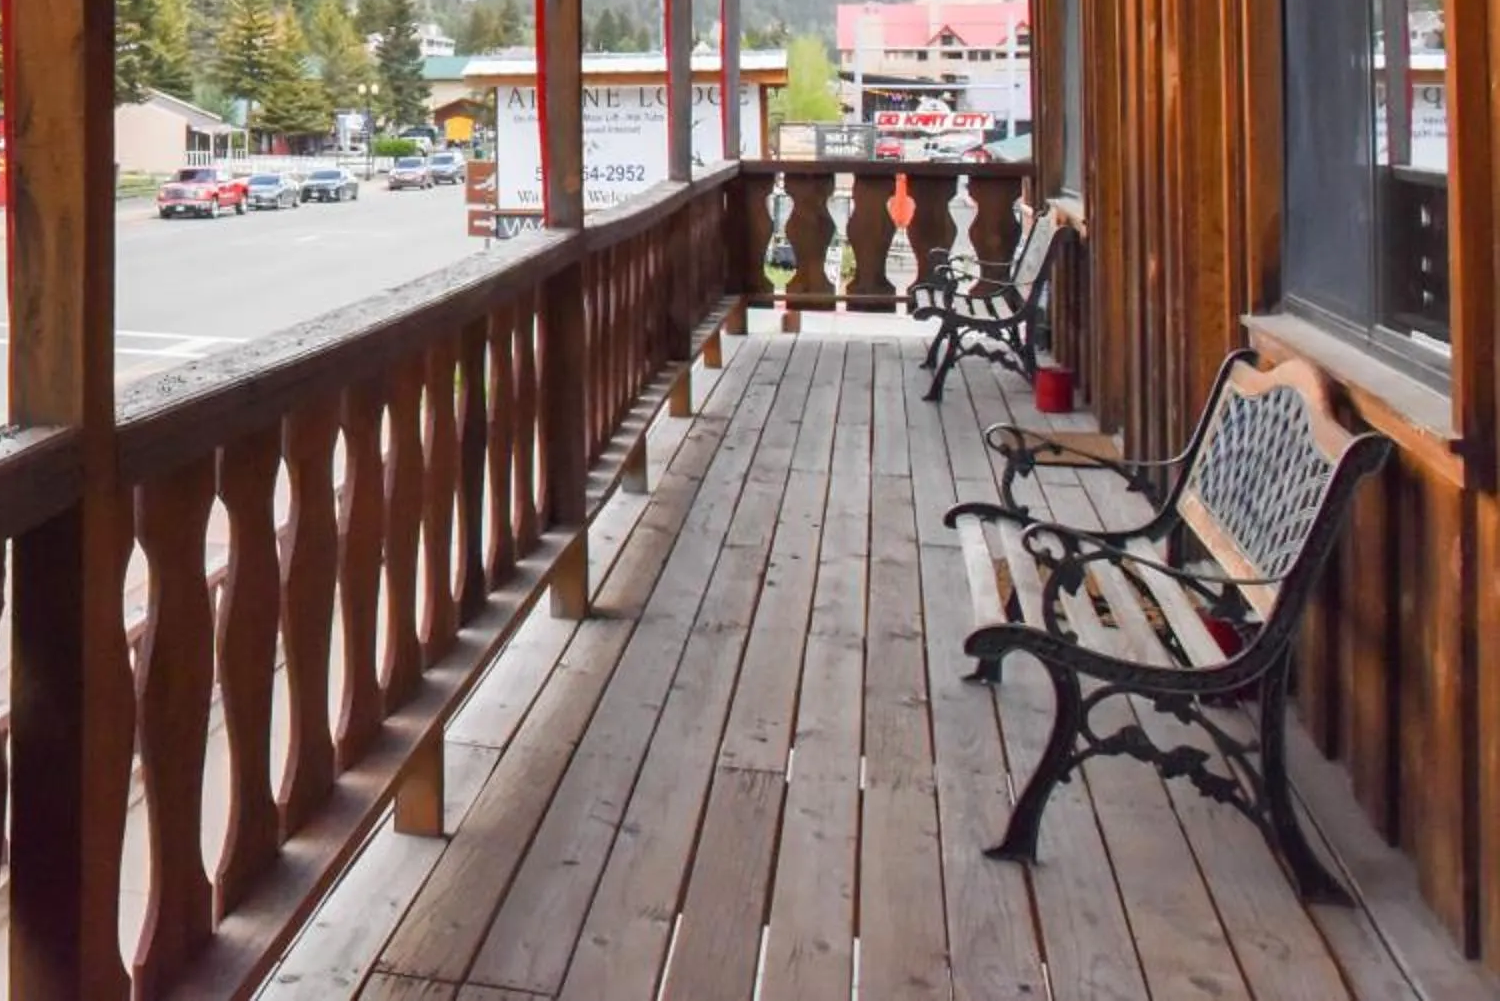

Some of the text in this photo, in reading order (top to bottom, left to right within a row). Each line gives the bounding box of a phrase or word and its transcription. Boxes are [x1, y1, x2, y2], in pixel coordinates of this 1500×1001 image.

[507, 85, 621, 110] ALNE
[877, 112, 990, 128] GO KART CITY
